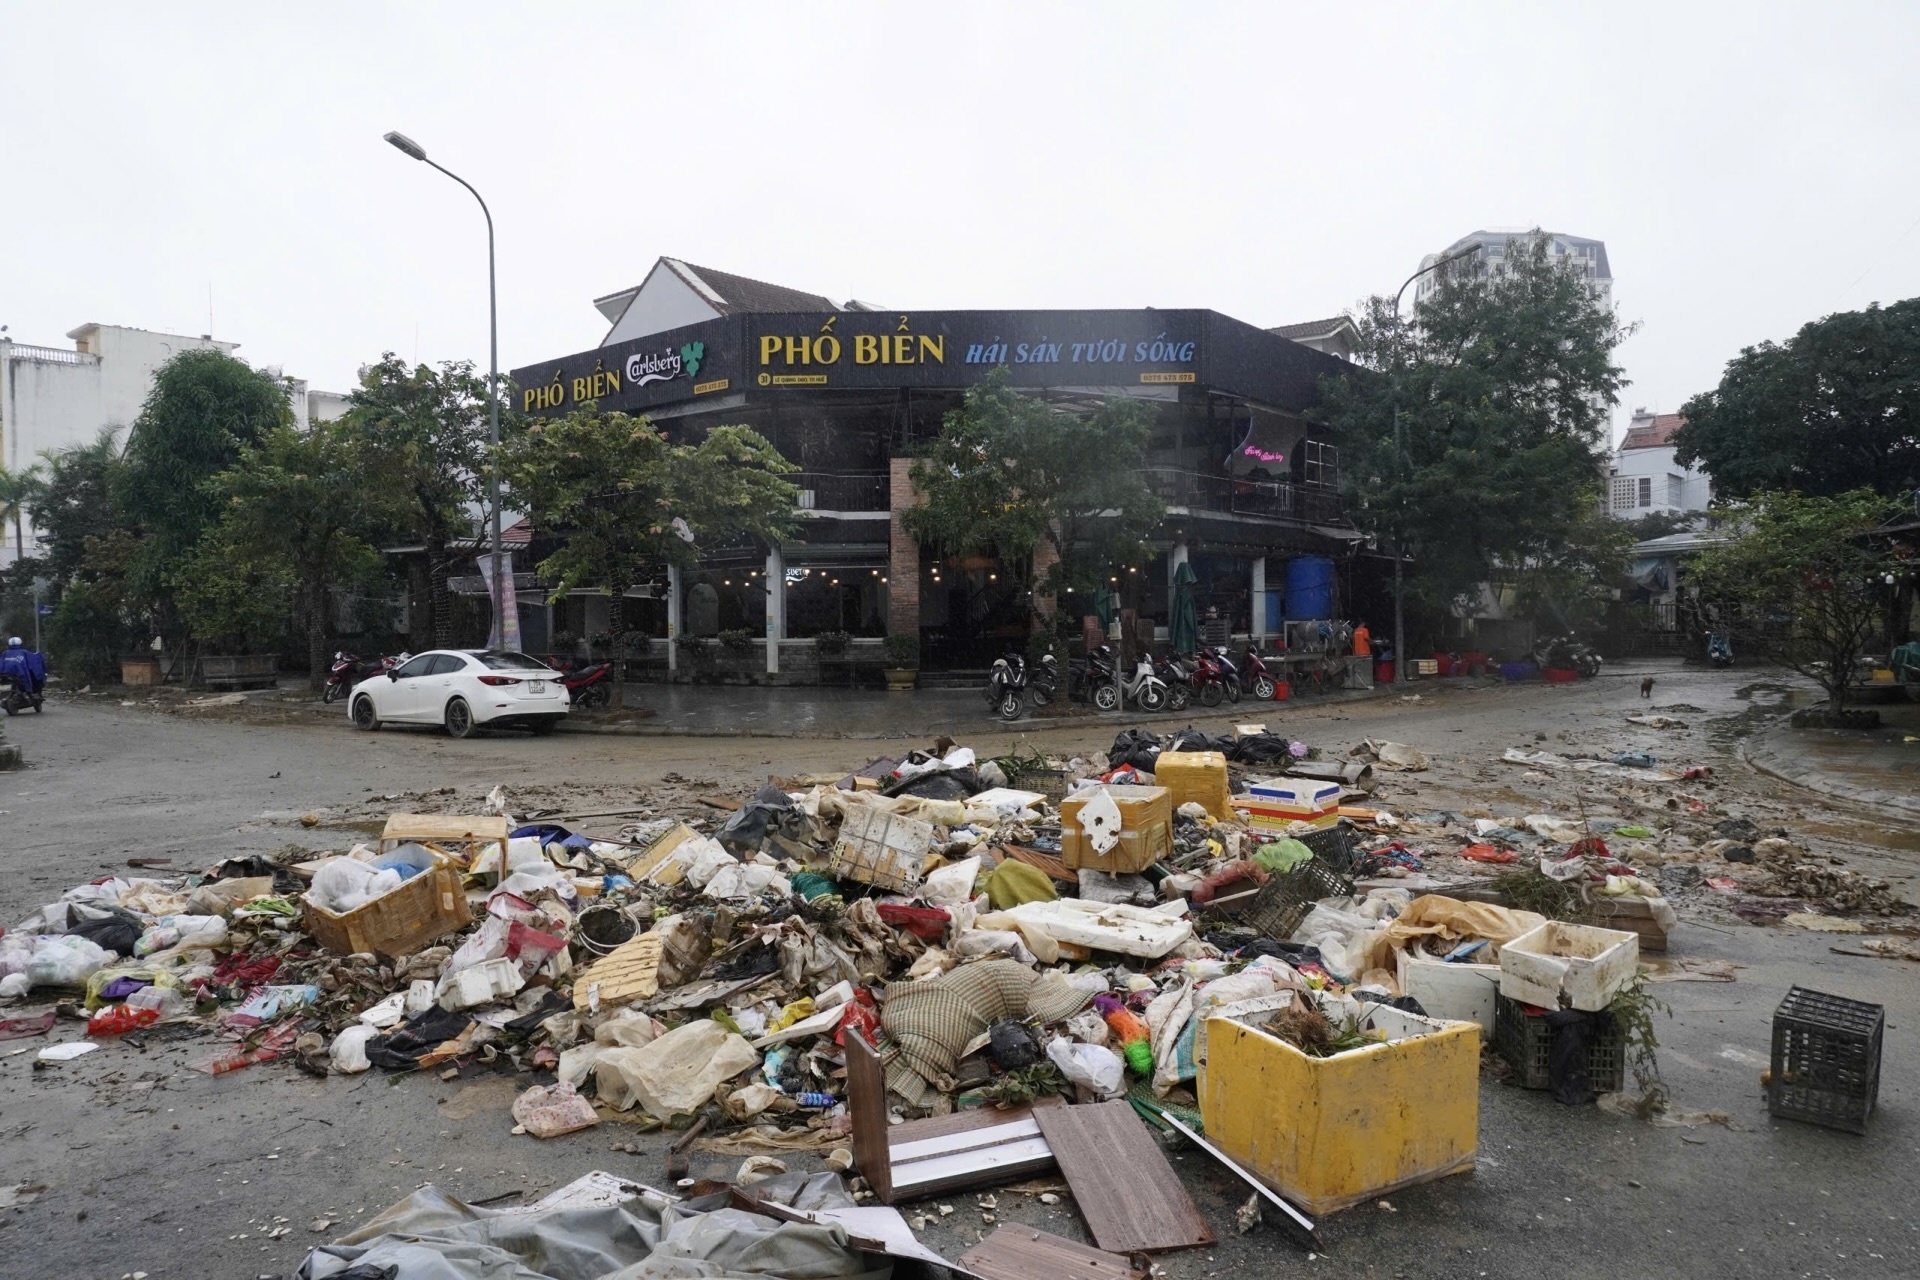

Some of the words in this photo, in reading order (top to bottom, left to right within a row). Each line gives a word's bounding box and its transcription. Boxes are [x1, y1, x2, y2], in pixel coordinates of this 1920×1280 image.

[759, 316, 841, 366] PHỐ
[855, 315, 945, 366] BIỂN
[965, 334, 1008, 365] HẢI
[1015, 334, 1062, 363] SẢN
[1072, 339, 1126, 362] TƯƠI
[1134, 331, 1195, 363] SỐNG
[524, 370, 564, 412] PHỐ
[573, 358, 620, 401] BIỂN
[626, 347, 681, 386] Carlsberg
